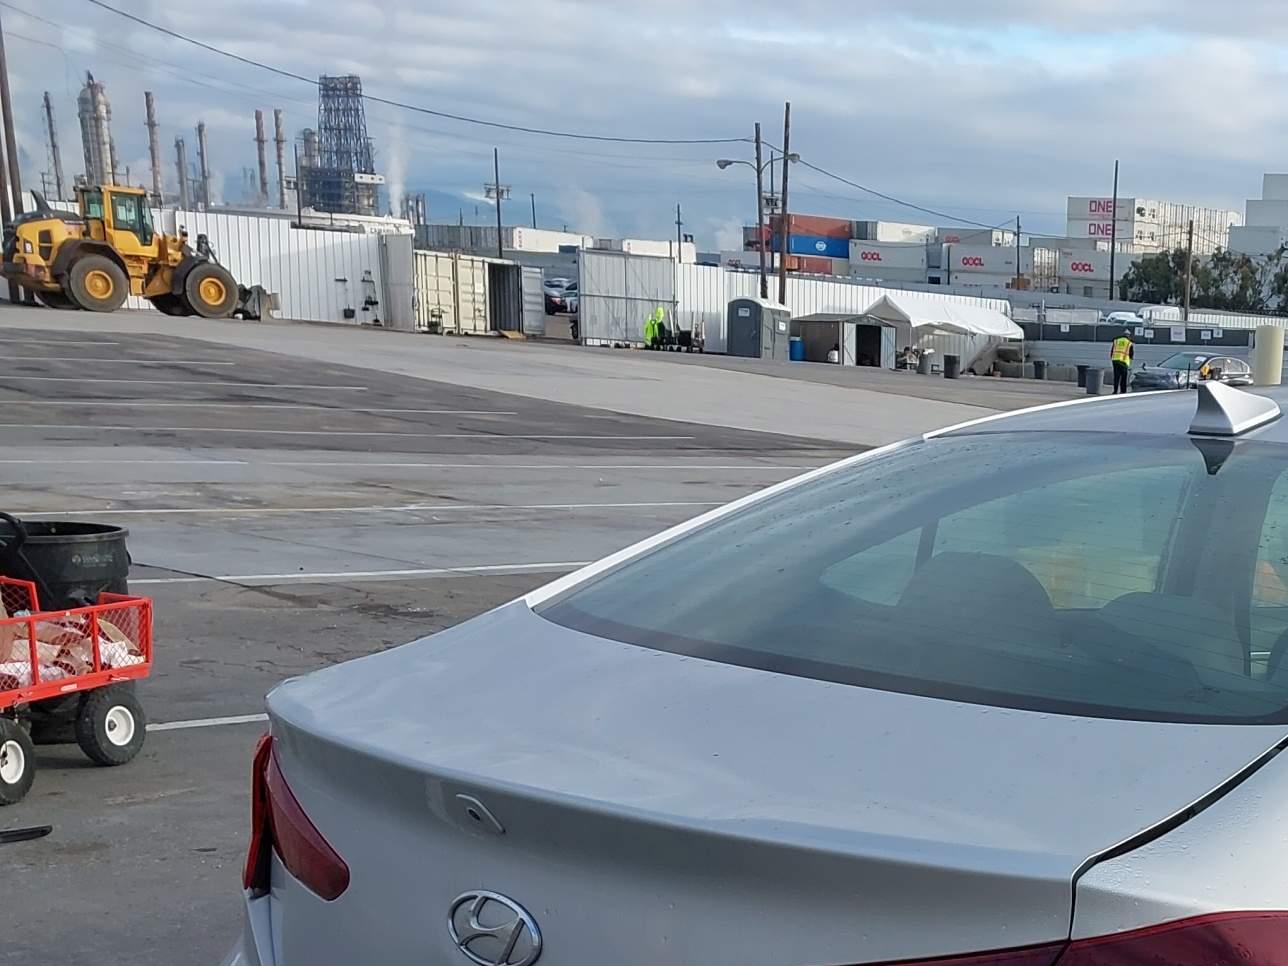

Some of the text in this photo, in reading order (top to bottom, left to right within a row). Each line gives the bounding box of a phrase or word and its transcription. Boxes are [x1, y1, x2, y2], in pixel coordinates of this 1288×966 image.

[1089, 200, 1113, 213] ONE
[1088, 223, 1113, 236] ONE
[861, 251, 882, 261] OOCL
[961, 256, 985, 267] OOCL
[1071, 262, 1095, 273] OOCL
